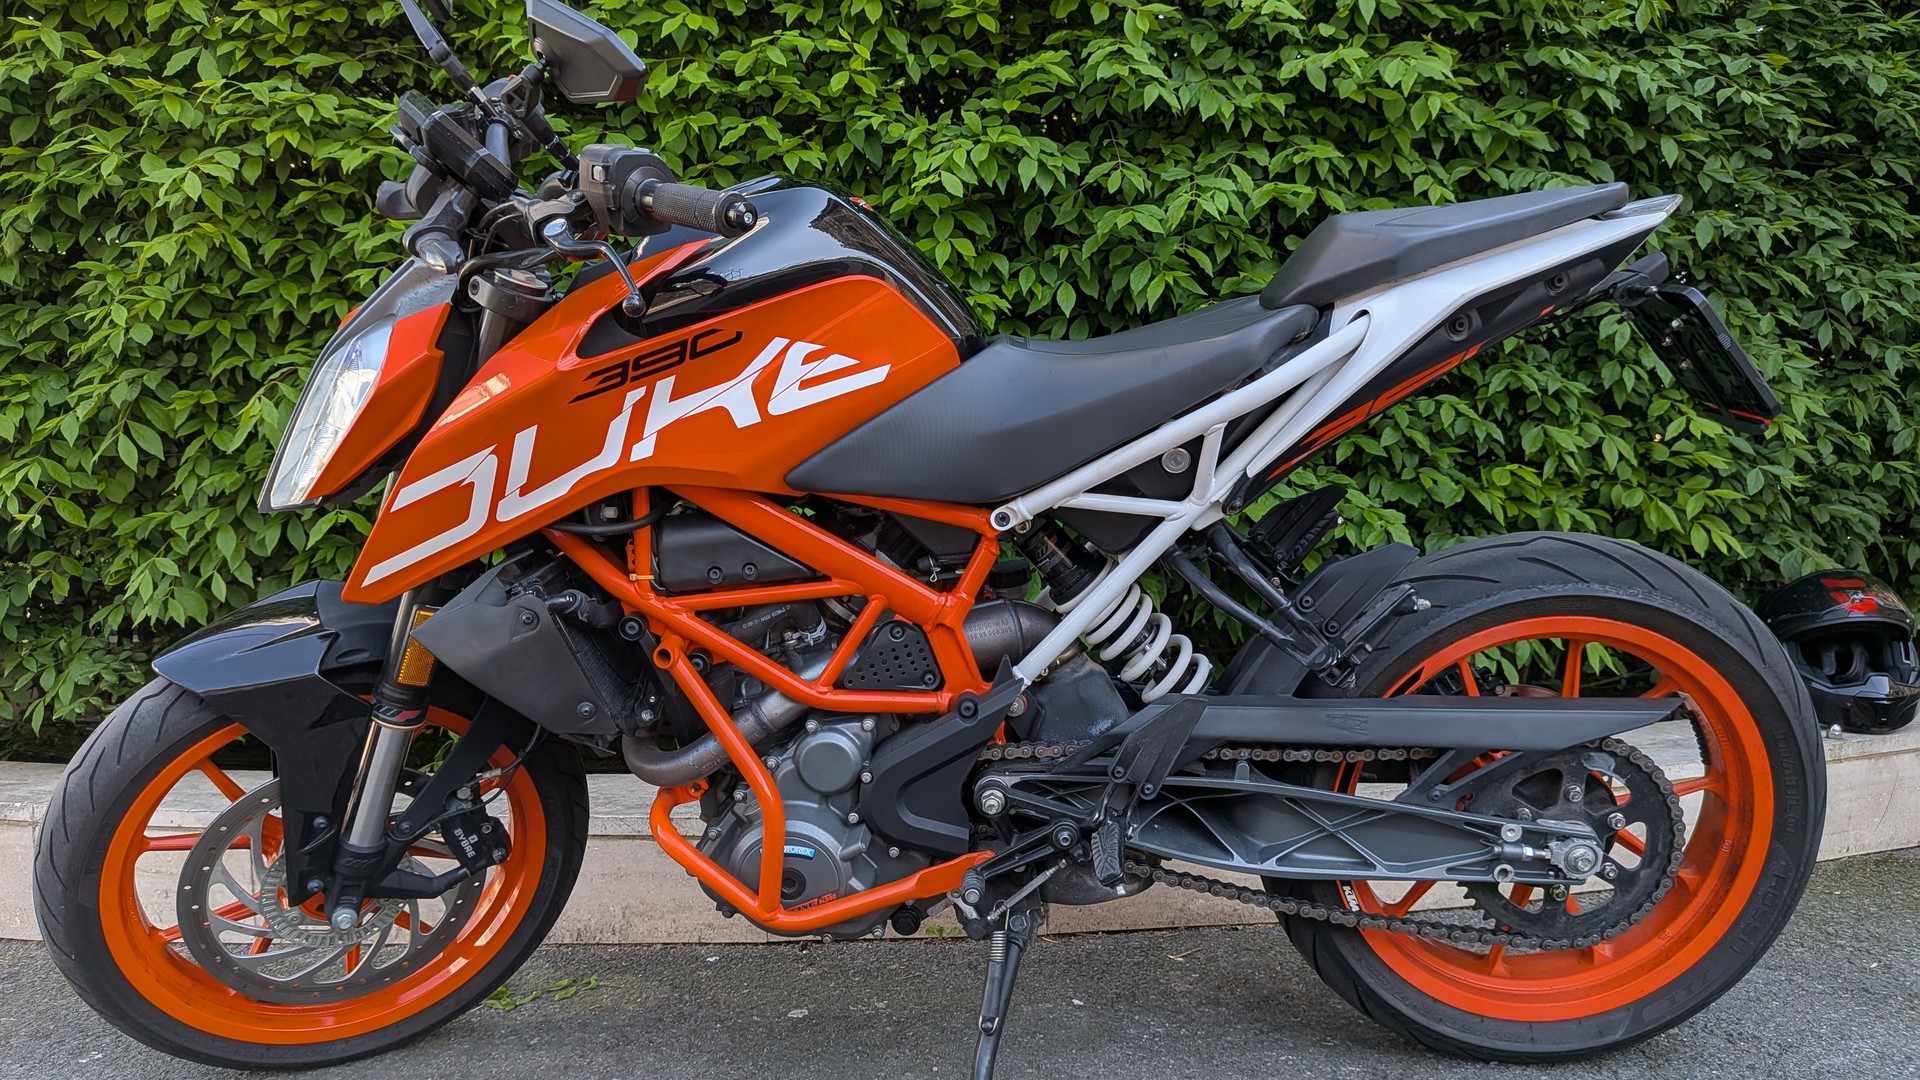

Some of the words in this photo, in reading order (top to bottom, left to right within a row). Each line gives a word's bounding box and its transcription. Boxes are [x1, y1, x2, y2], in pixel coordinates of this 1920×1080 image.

[568, 328, 743, 403] 390
[361, 336, 892, 587] DUKE
[454, 828, 476, 859] BYBRE
[1342, 885, 1360, 912] KTM
